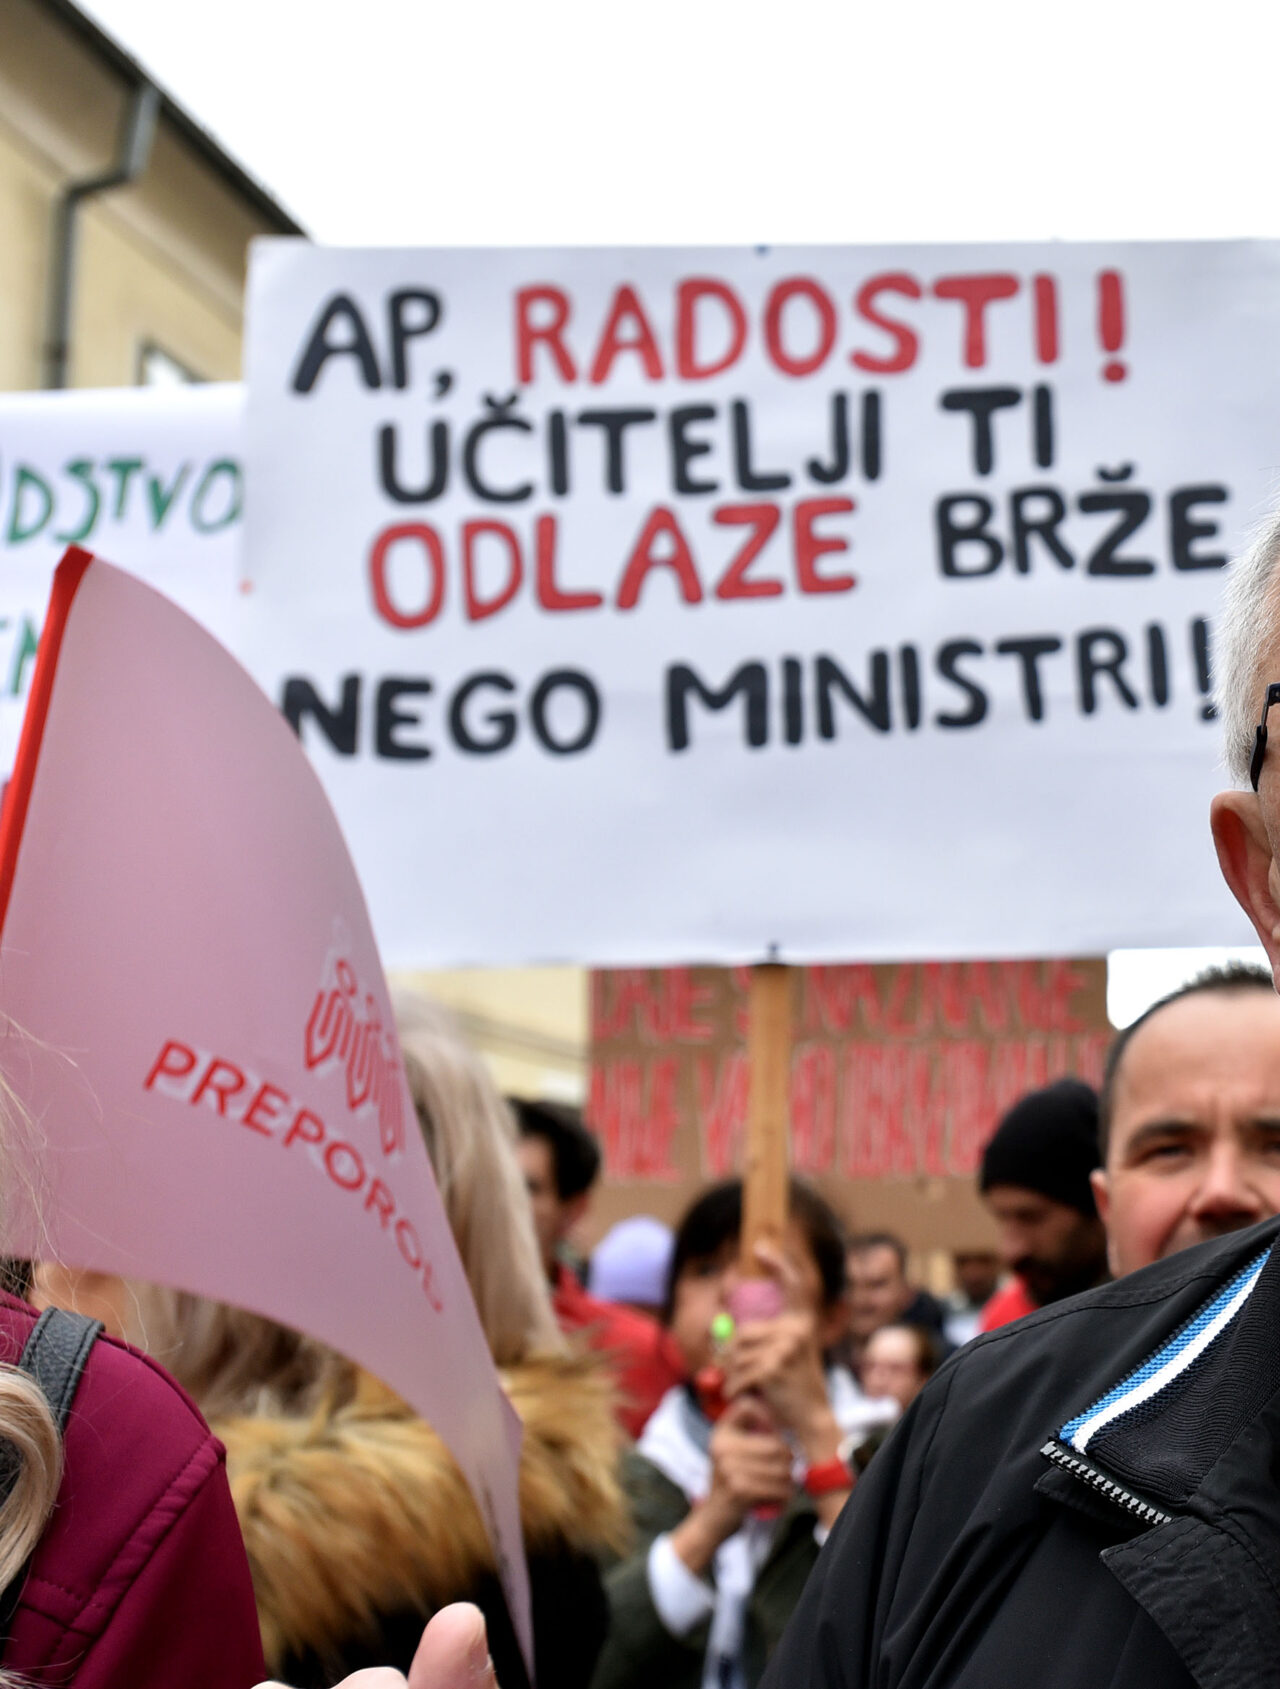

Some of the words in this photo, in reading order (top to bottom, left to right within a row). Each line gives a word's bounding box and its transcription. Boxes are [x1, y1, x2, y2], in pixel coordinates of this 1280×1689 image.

[290, 284, 456, 398] AP,
[513, 269, 1129, 387] RADOSTI!
[378, 387, 883, 506] UČITELJI
[939, 382, 1055, 478] TI
[368, 495, 857, 632] ODLAZE
[934, 462, 1231, 579] BRŽE
[280, 667, 603, 761] NEGO
[664, 614, 1222, 754] MINISTRI!
